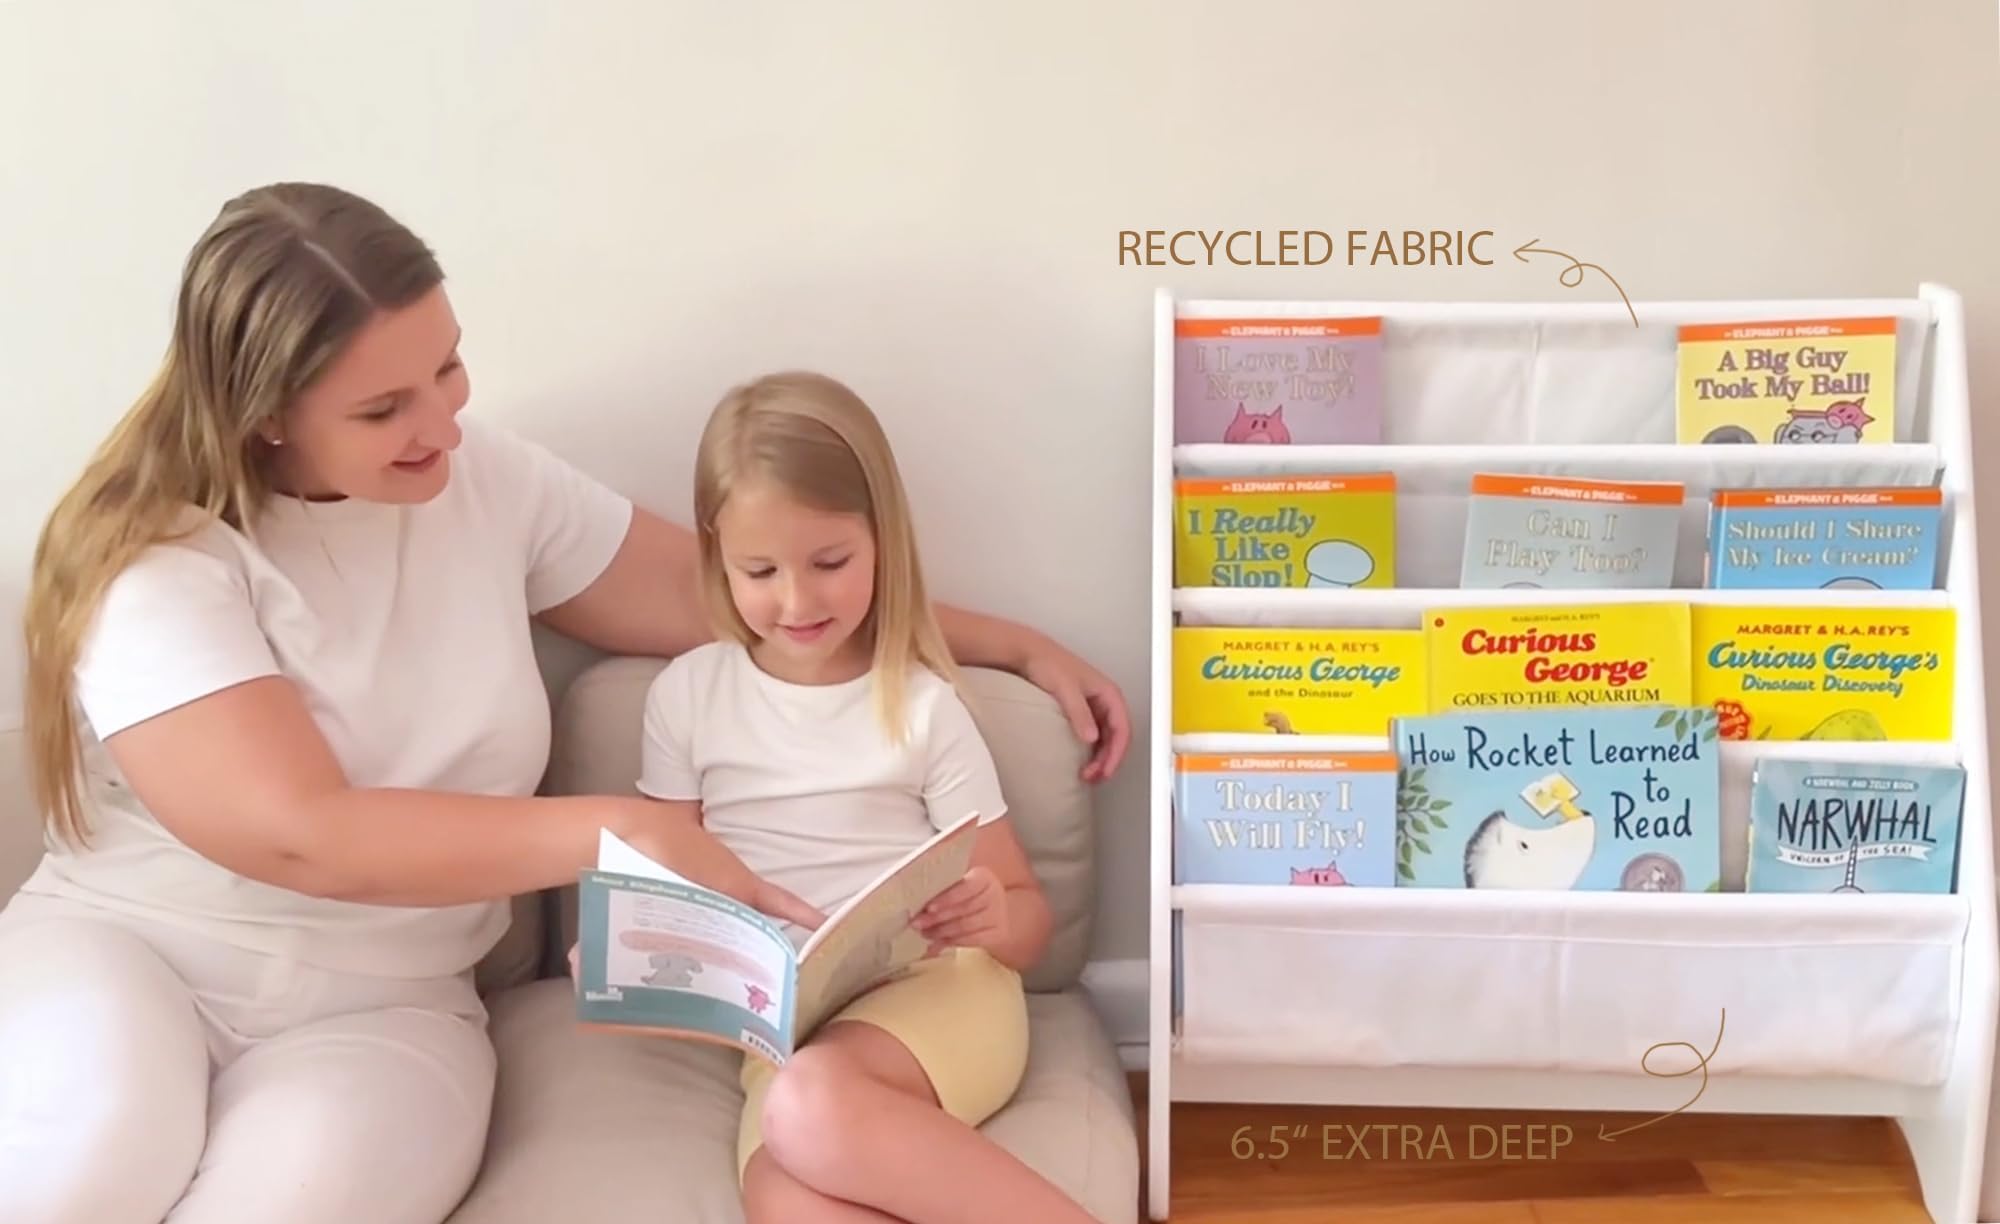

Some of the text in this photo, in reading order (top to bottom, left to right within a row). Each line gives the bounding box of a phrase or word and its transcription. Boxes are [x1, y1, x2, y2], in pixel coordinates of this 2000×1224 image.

[1195, 345, 1357, 374] I Love My
[1717, 346, 1848, 375] A Big Guy
[1207, 373, 1356, 406] New Toy!
[1695, 373, 1870, 401] Took My Ball!
[1188, 507, 1315, 538] I Really
[1528, 508, 1618, 542] Can I
[1728, 519, 1921, 540] Should I Share
[1215, 536, 1290, 562] Like
[1485, 538, 1649, 576] Play Too?
[1728, 546, 1919, 570] My Ice Cream?
[1211, 563, 1293, 588] Slop!
[1462, 628, 1596, 655] Curious
[1737, 624, 1812, 635] MARGRET
[1817, 625, 1828, 635] &
[1868, 625, 1910, 636] REY'S
[1223, 641, 1290, 651] MARGRET
[1296, 642, 1304, 651] &
[1342, 642, 1380, 653] REY'S
[1707, 640, 1938, 679] Curious George's
[1202, 655, 1401, 688] Curious George
[1524, 656, 1648, 687] George
[1741, 674, 1903, 698] Dinosaur Discovery
[1248, 688, 1353, 698] and the Dinosaur
[1453, 689, 1660, 706] GOES TO THE AQUARIUM
[1409, 726, 1700, 771] How Rocket Learned
[1215, 779, 1353, 818] Today I
[1642, 768, 1671, 803] to
[1611, 791, 1693, 841] Read
[1777, 797, 1937, 851] NARWHAL
[1203, 819, 1367, 857] Will Fly!
